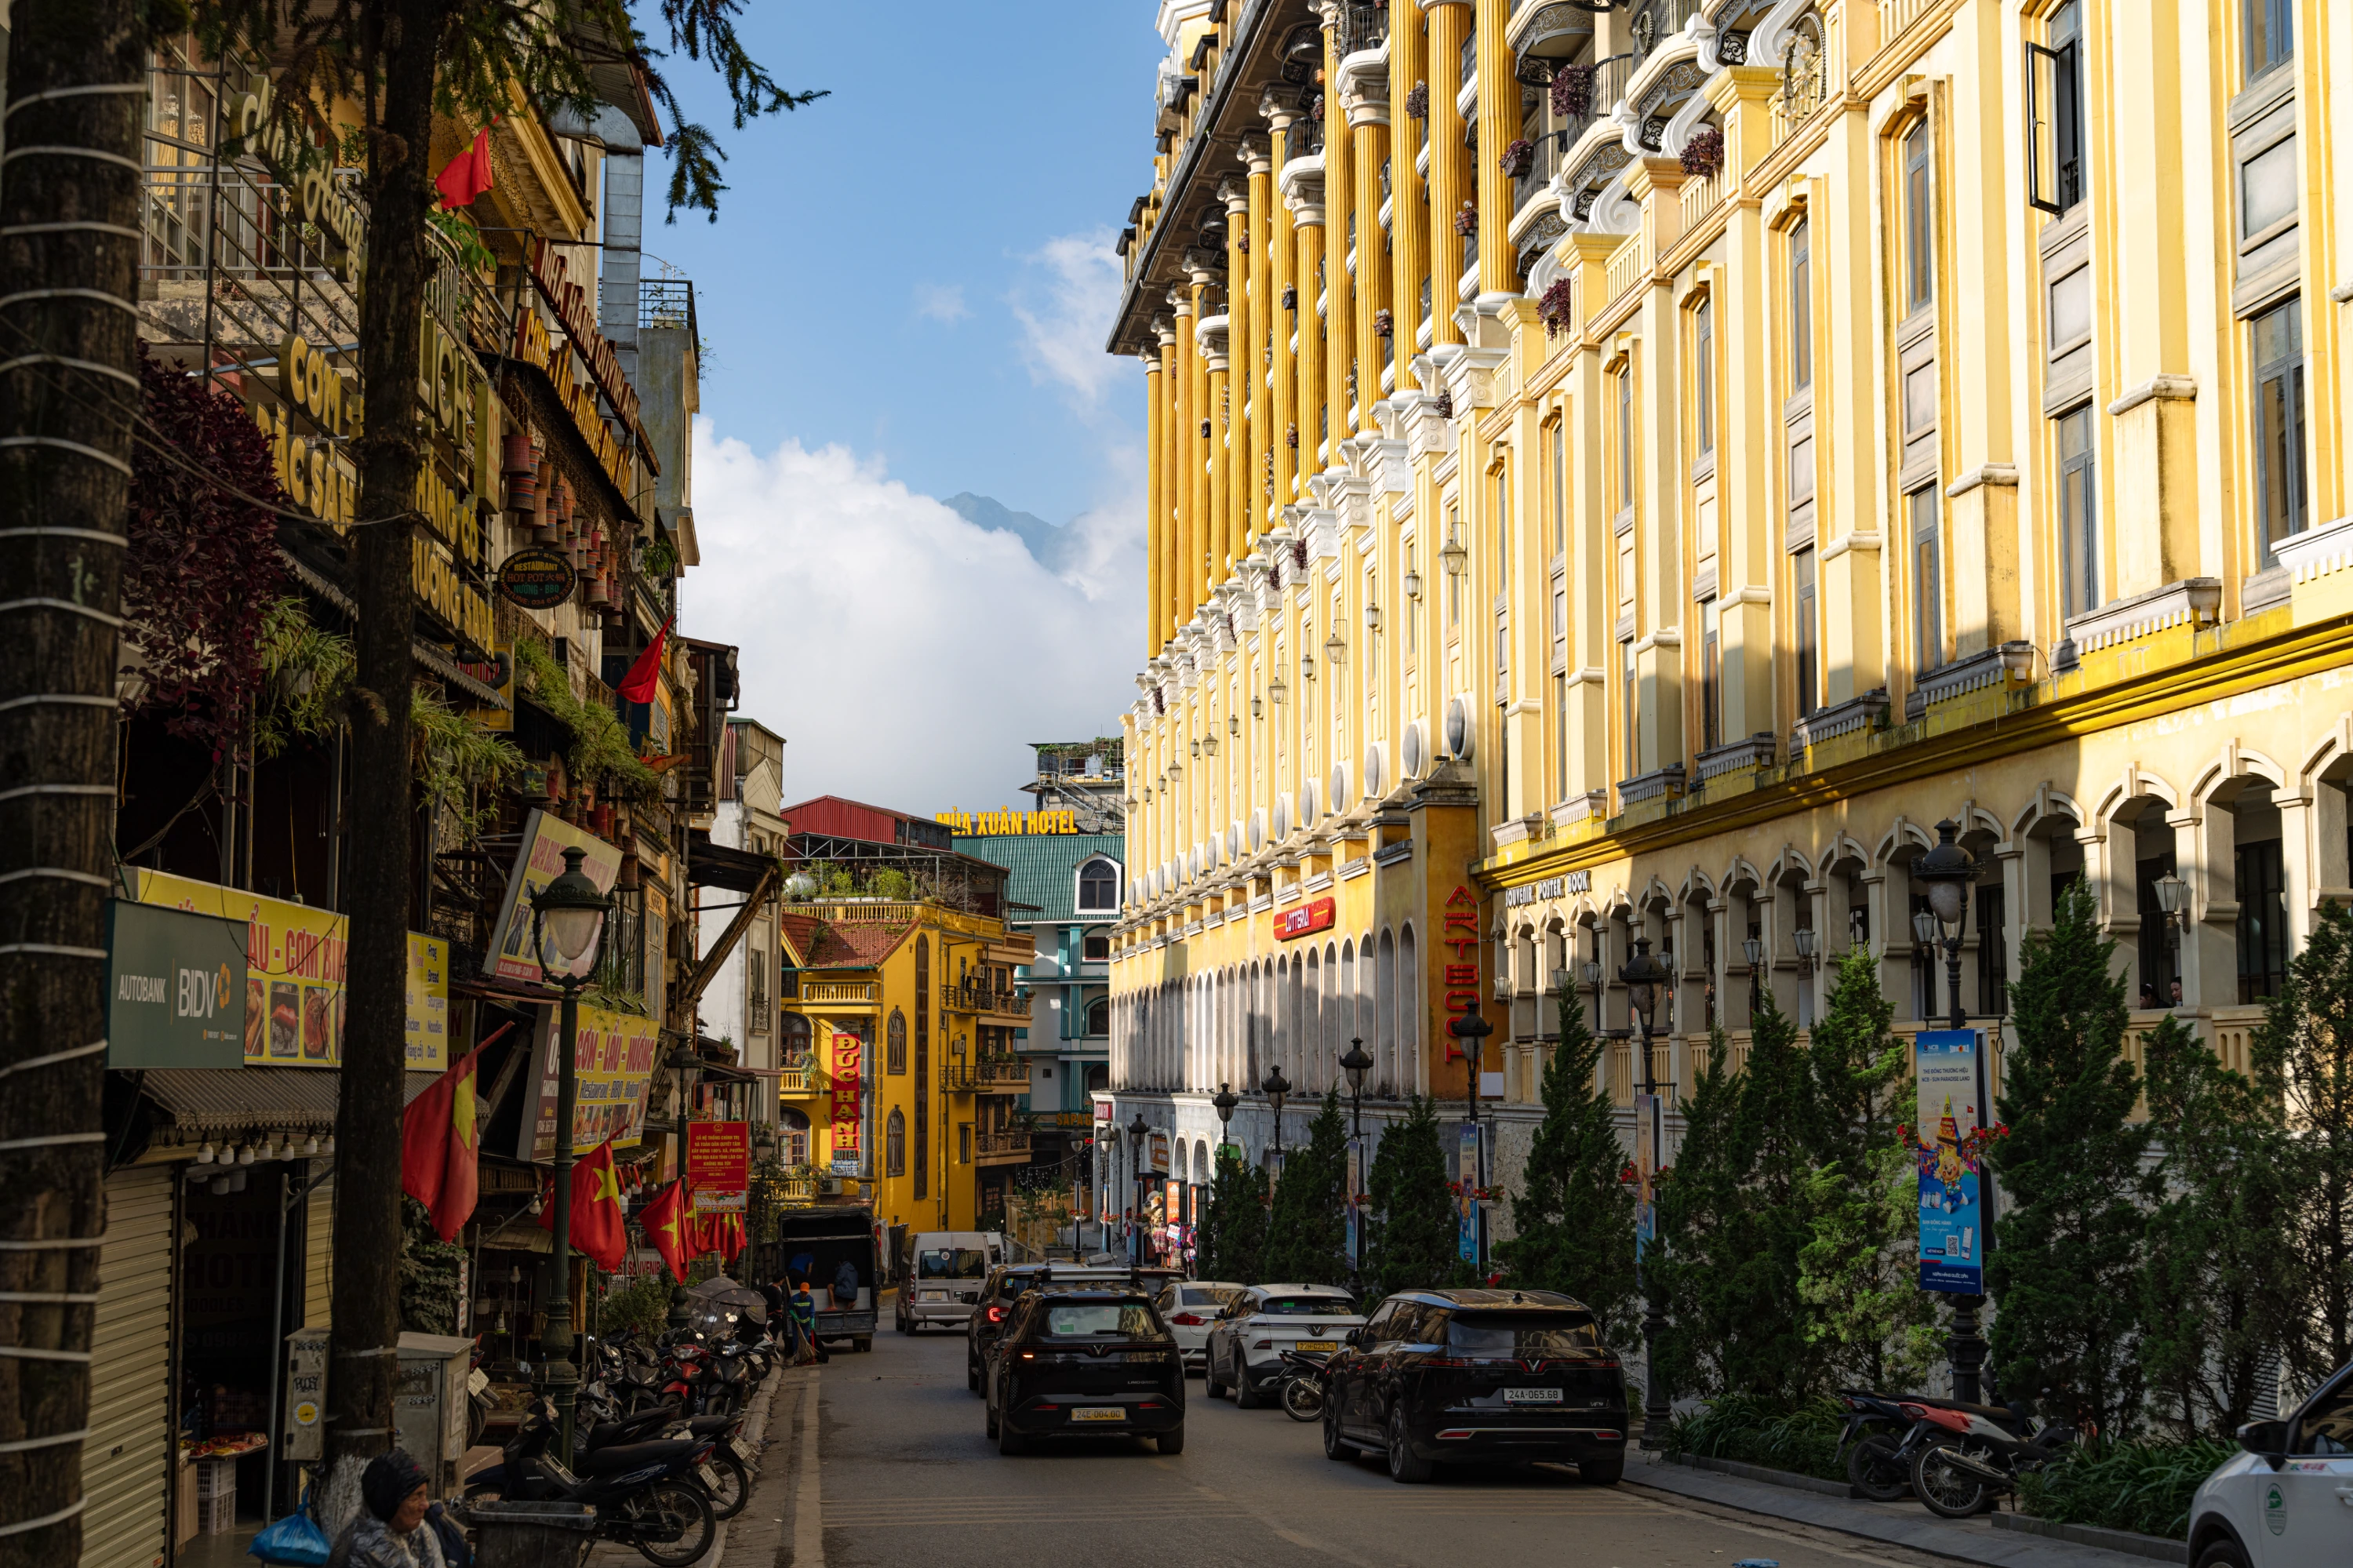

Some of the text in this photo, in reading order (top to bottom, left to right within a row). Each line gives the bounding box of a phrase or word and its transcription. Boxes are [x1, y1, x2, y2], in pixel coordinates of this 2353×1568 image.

[290, 336, 341, 436] CƠM
[489, 404, 498, 453] 01
[514, 561, 558, 572] RESTAURANT
[507, 573, 526, 582] HOT
[527, 573, 545, 582] POT
[514, 582, 539, 595] NƯỚNG
[545, 584, 560, 594] BBQ
[464, 583, 495, 661] SAPA
[935, 805, 1078, 835] MÙA XUÂN HOTEL
[1506, 870, 1587, 908] SOUVENIR POSTER BOOK
[1286, 907, 1310, 933] LOTTERIA
[248, 904, 270, 972] ẨU
[285, 928, 319, 980] CƠM
[428, 944, 438, 962] Frog
[428, 969, 439, 984] Bread
[118, 974, 166, 1003] AUTOBANK
[177, 968, 219, 1019] BIDV
[428, 994, 445, 1012] Sturgeon
[427, 1019, 442, 1034] Noodles
[427, 1045, 437, 1059] Duck
[575, 1023, 599, 1072] CƠM
[602, 1017, 623, 1073] LẨU
[626, 1026, 655, 1073] NƯỚNG
[580, 1079, 608, 1100] Restaurant
[833, 1150, 858, 1160] HOTEL
[1508, 1390, 1558, 1399] 24A-065.68
